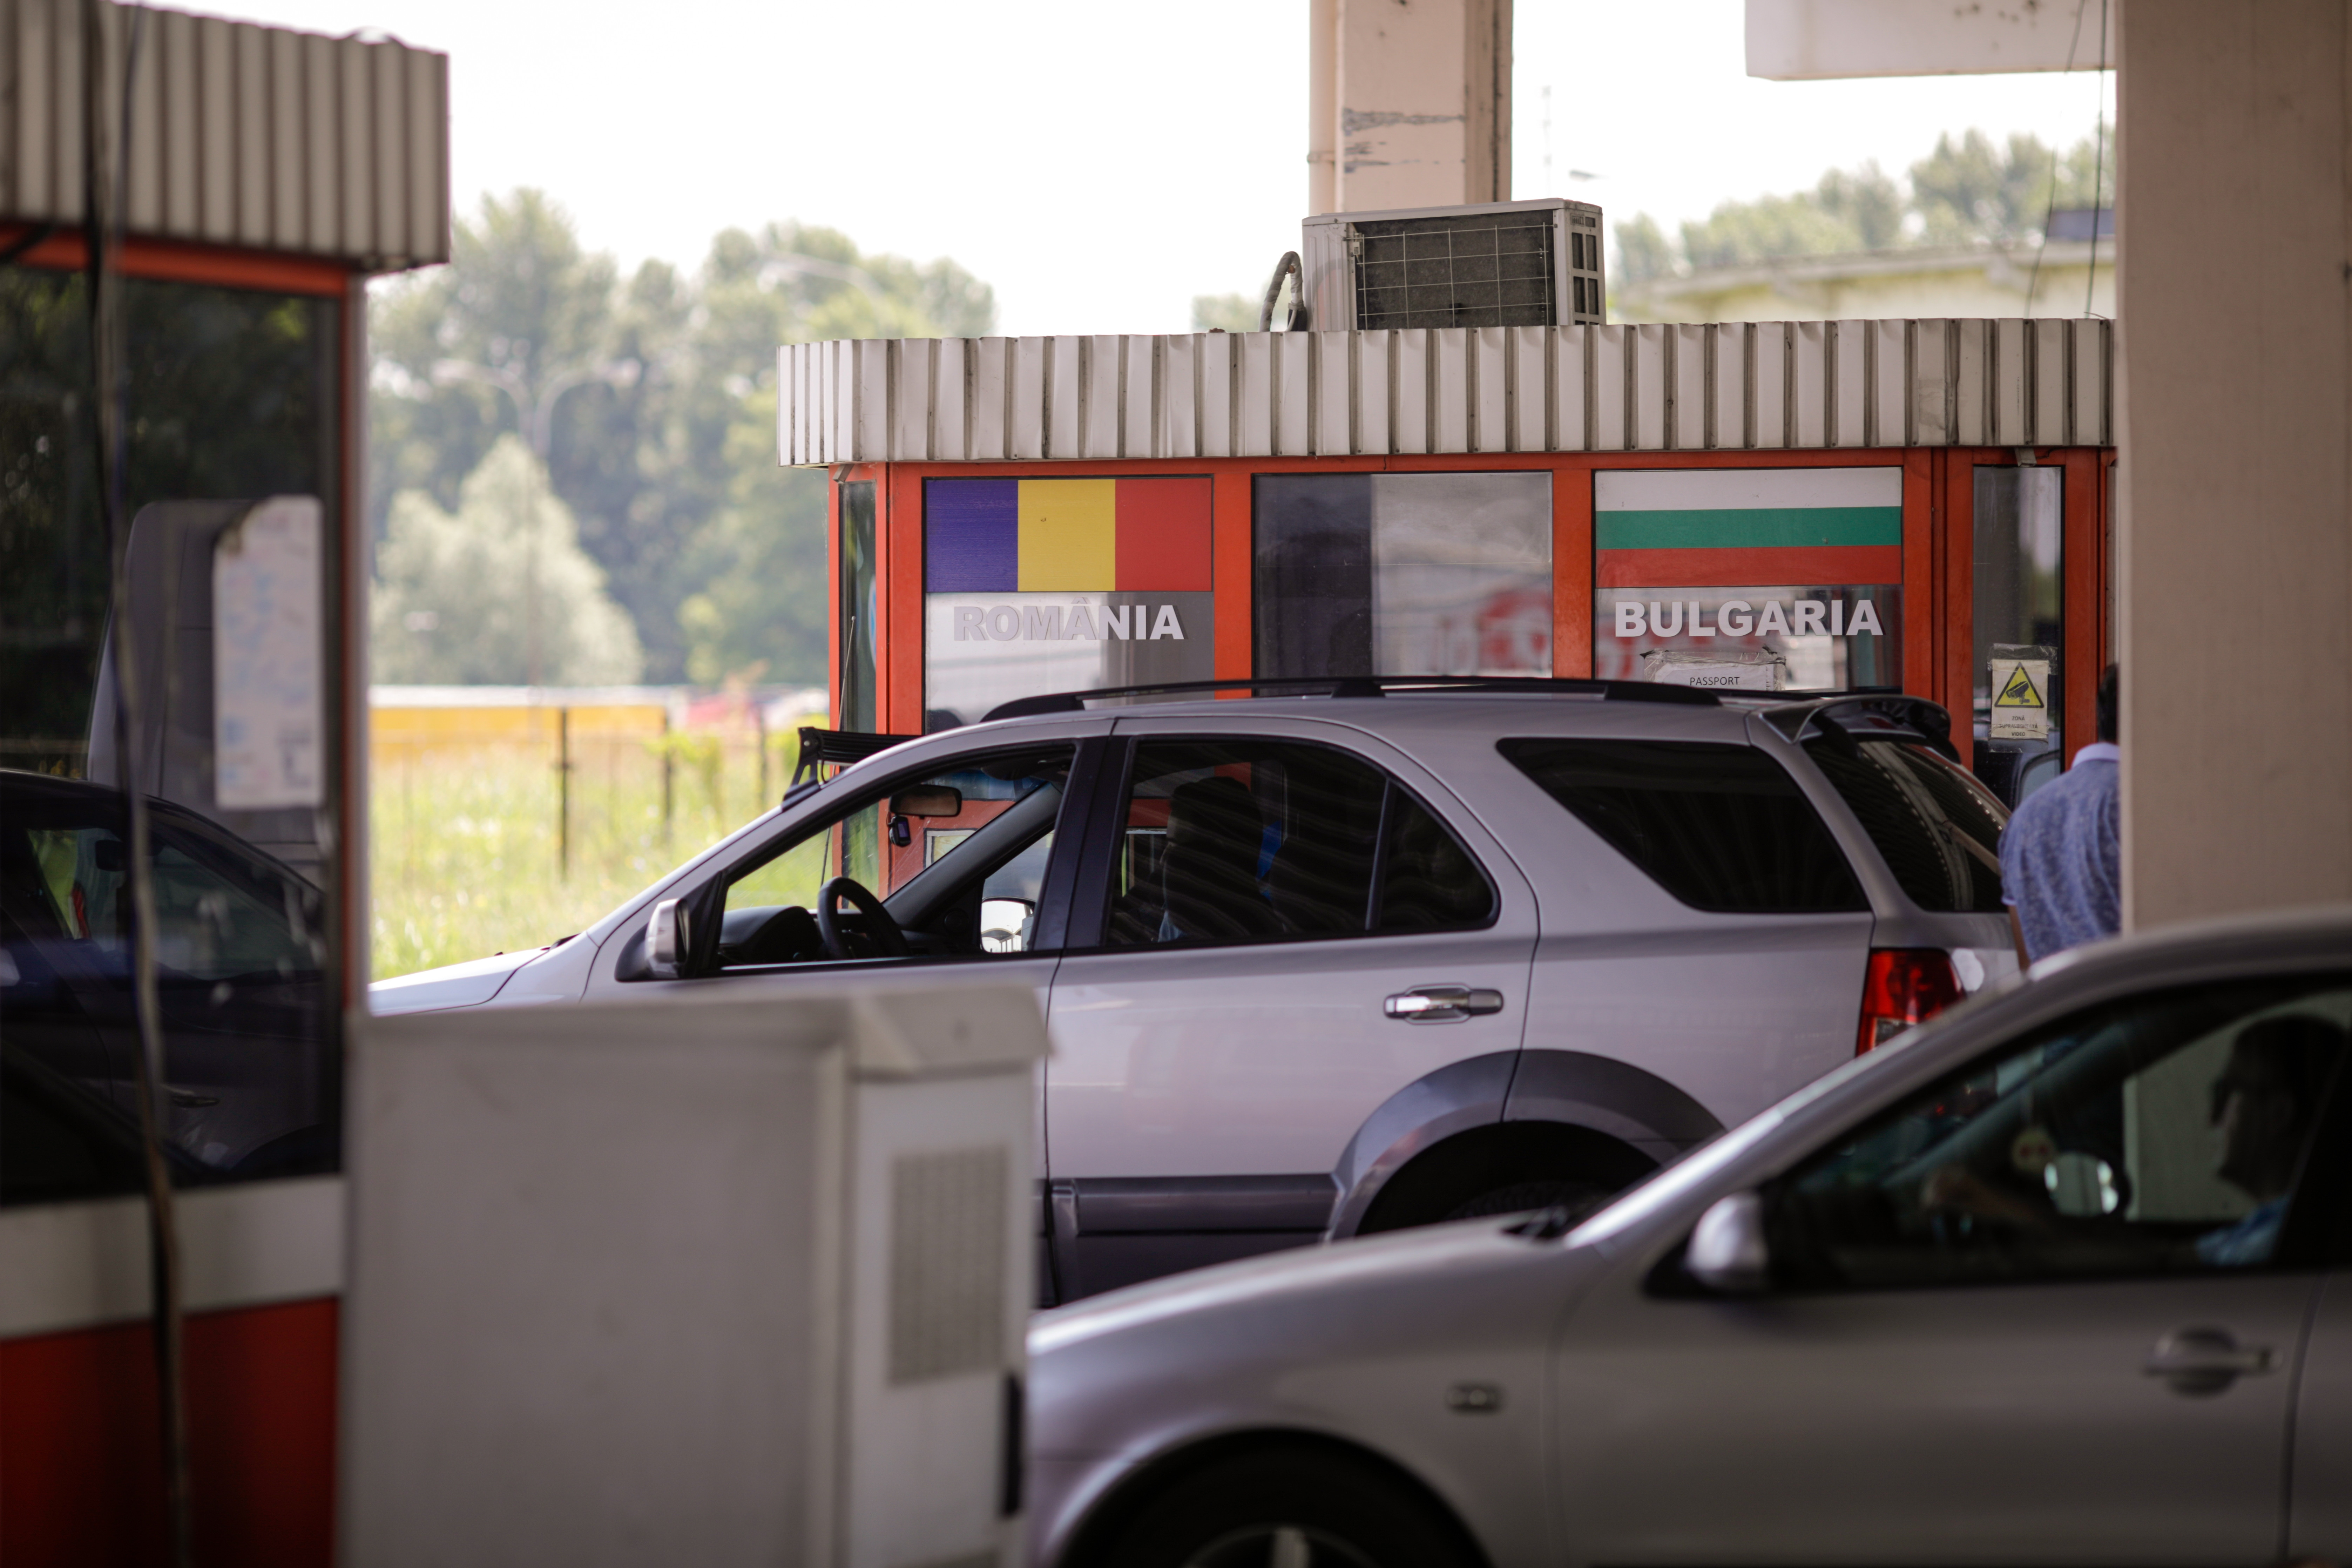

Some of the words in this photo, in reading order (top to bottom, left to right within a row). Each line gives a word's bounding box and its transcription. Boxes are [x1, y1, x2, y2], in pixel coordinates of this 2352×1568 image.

[954, 597, 1185, 641] ROMÂNIA
[1615, 599, 1884, 637] BULGARIA
[1690, 677, 1740, 686] PASSPORT
